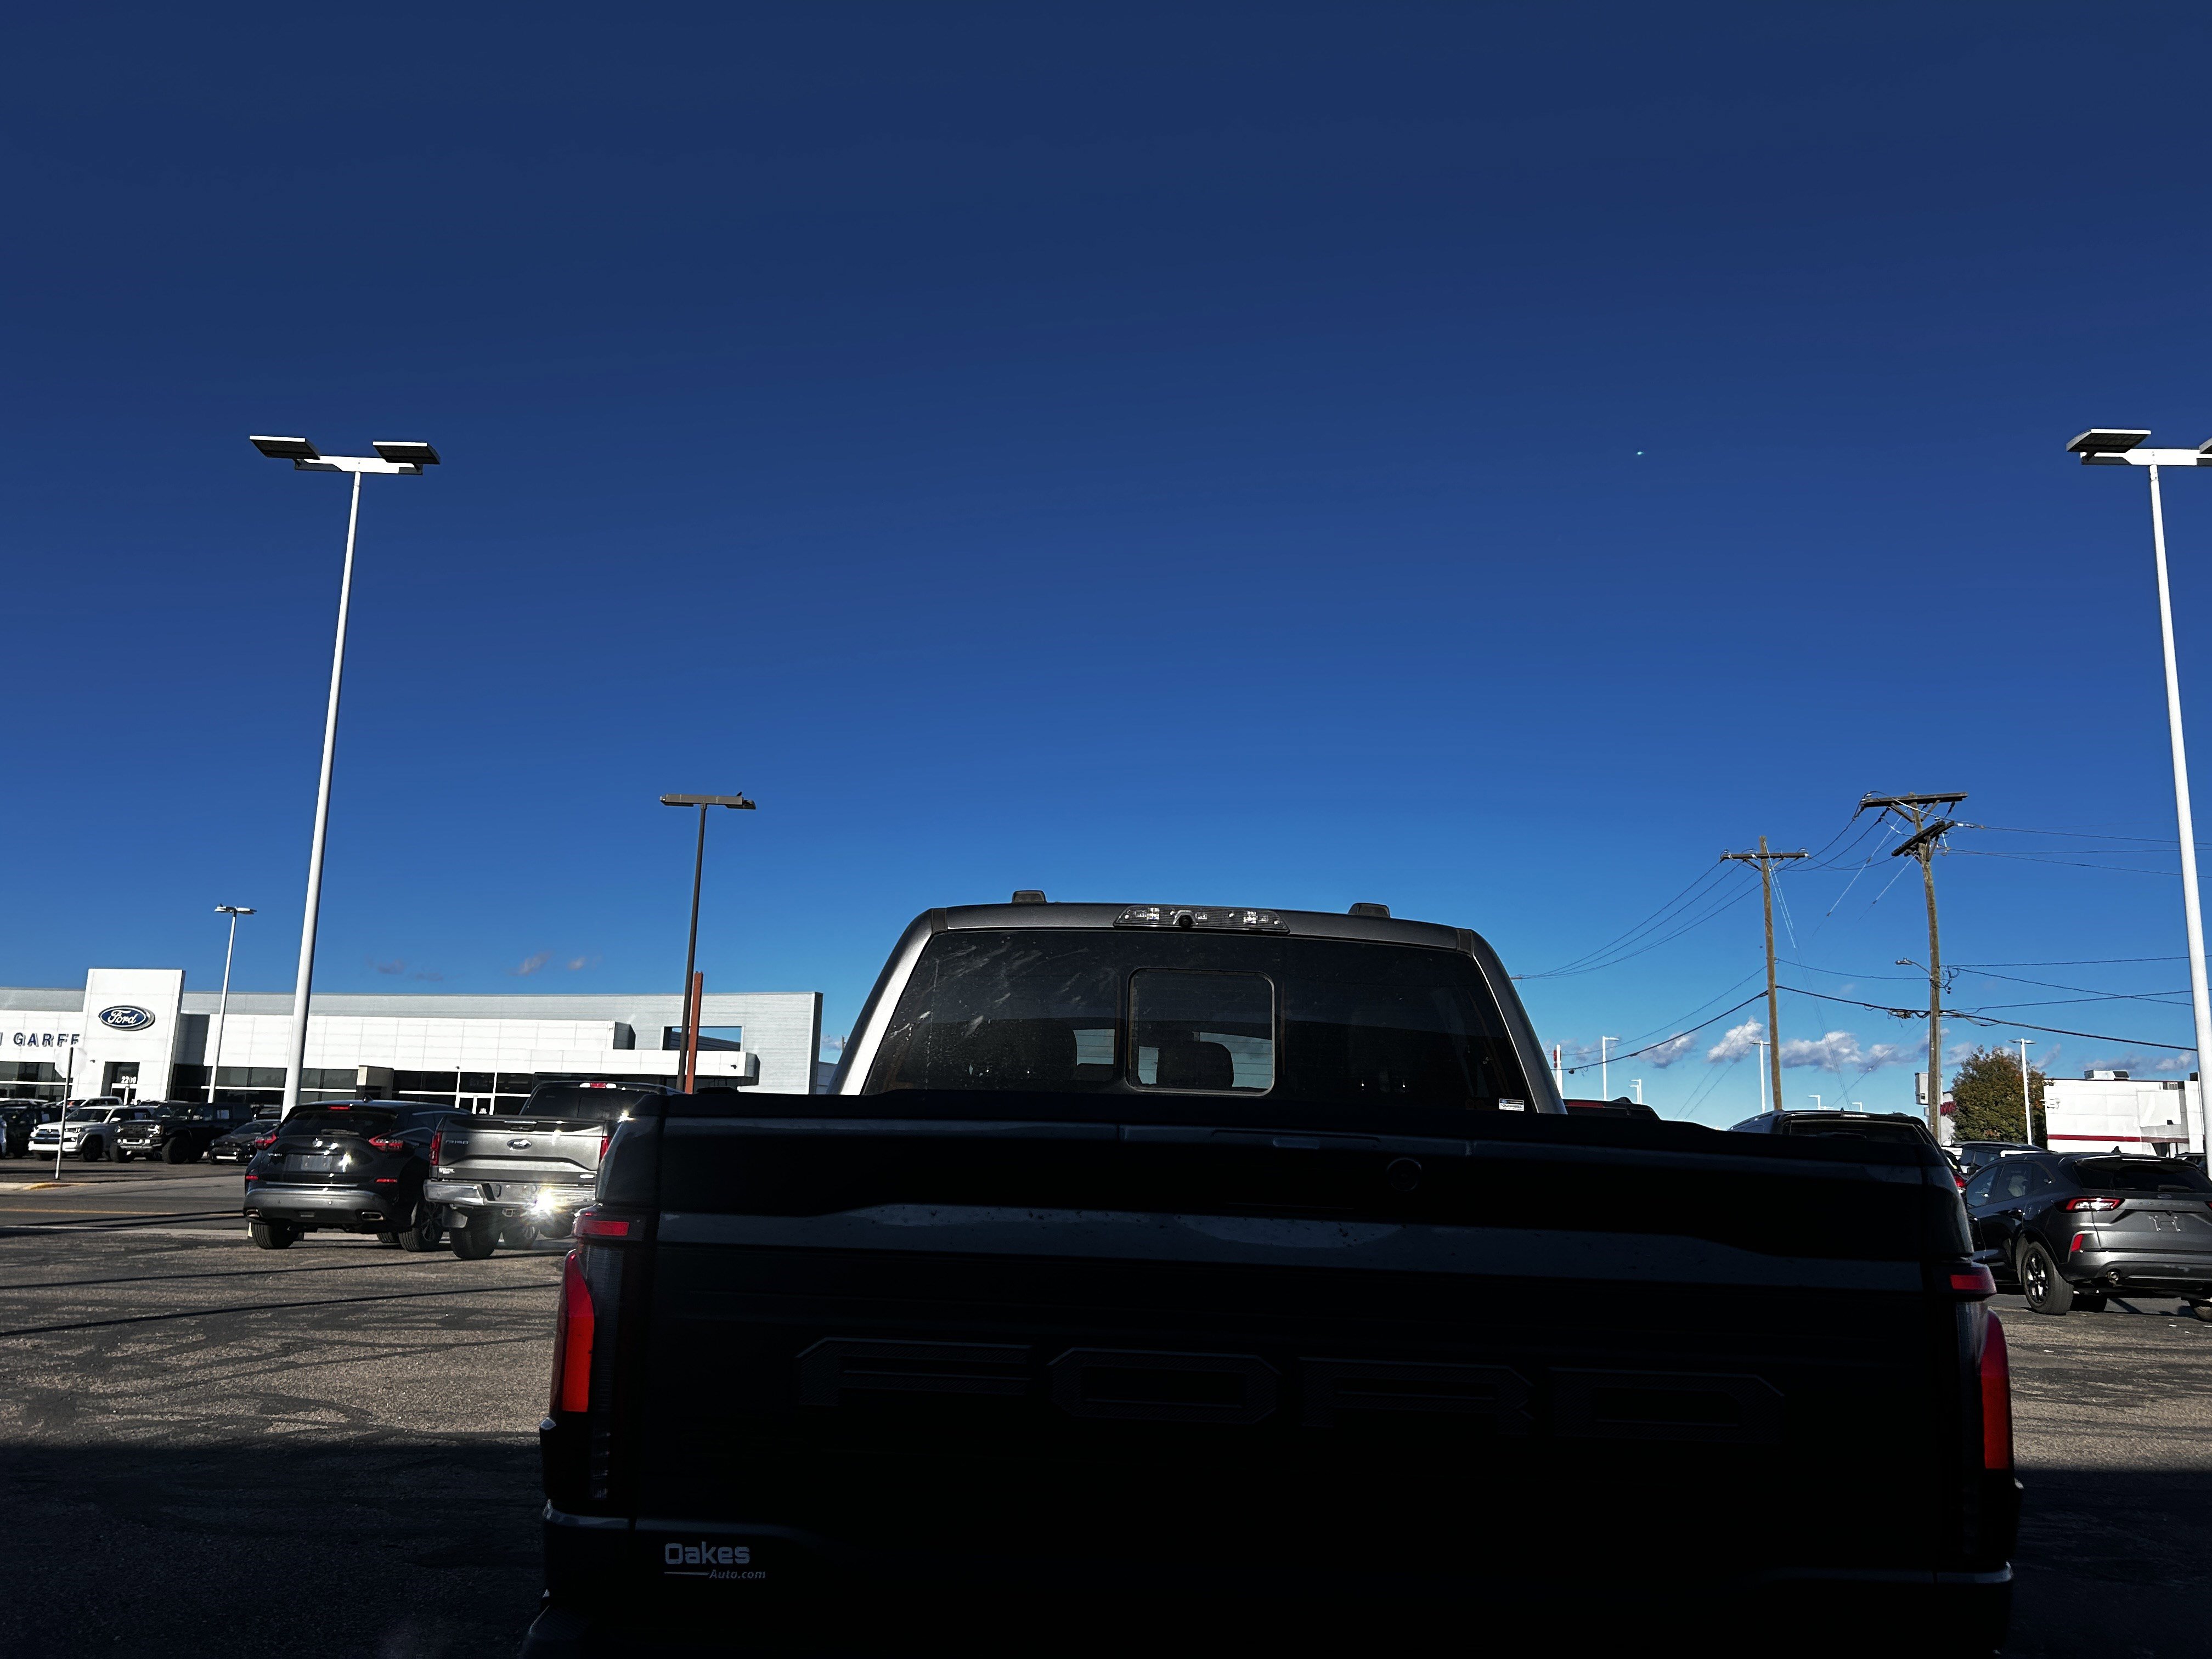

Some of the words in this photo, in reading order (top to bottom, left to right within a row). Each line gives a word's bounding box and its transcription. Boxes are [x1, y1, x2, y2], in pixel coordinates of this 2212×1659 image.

[107, 1009, 138, 1024] Ford
[13, 1032, 80, 1047] GARFF
[793, 1335, 1785, 1445] FORD
[665, 1541, 750, 1564] Oakes
[709, 1569, 766, 1579] Auto.com
